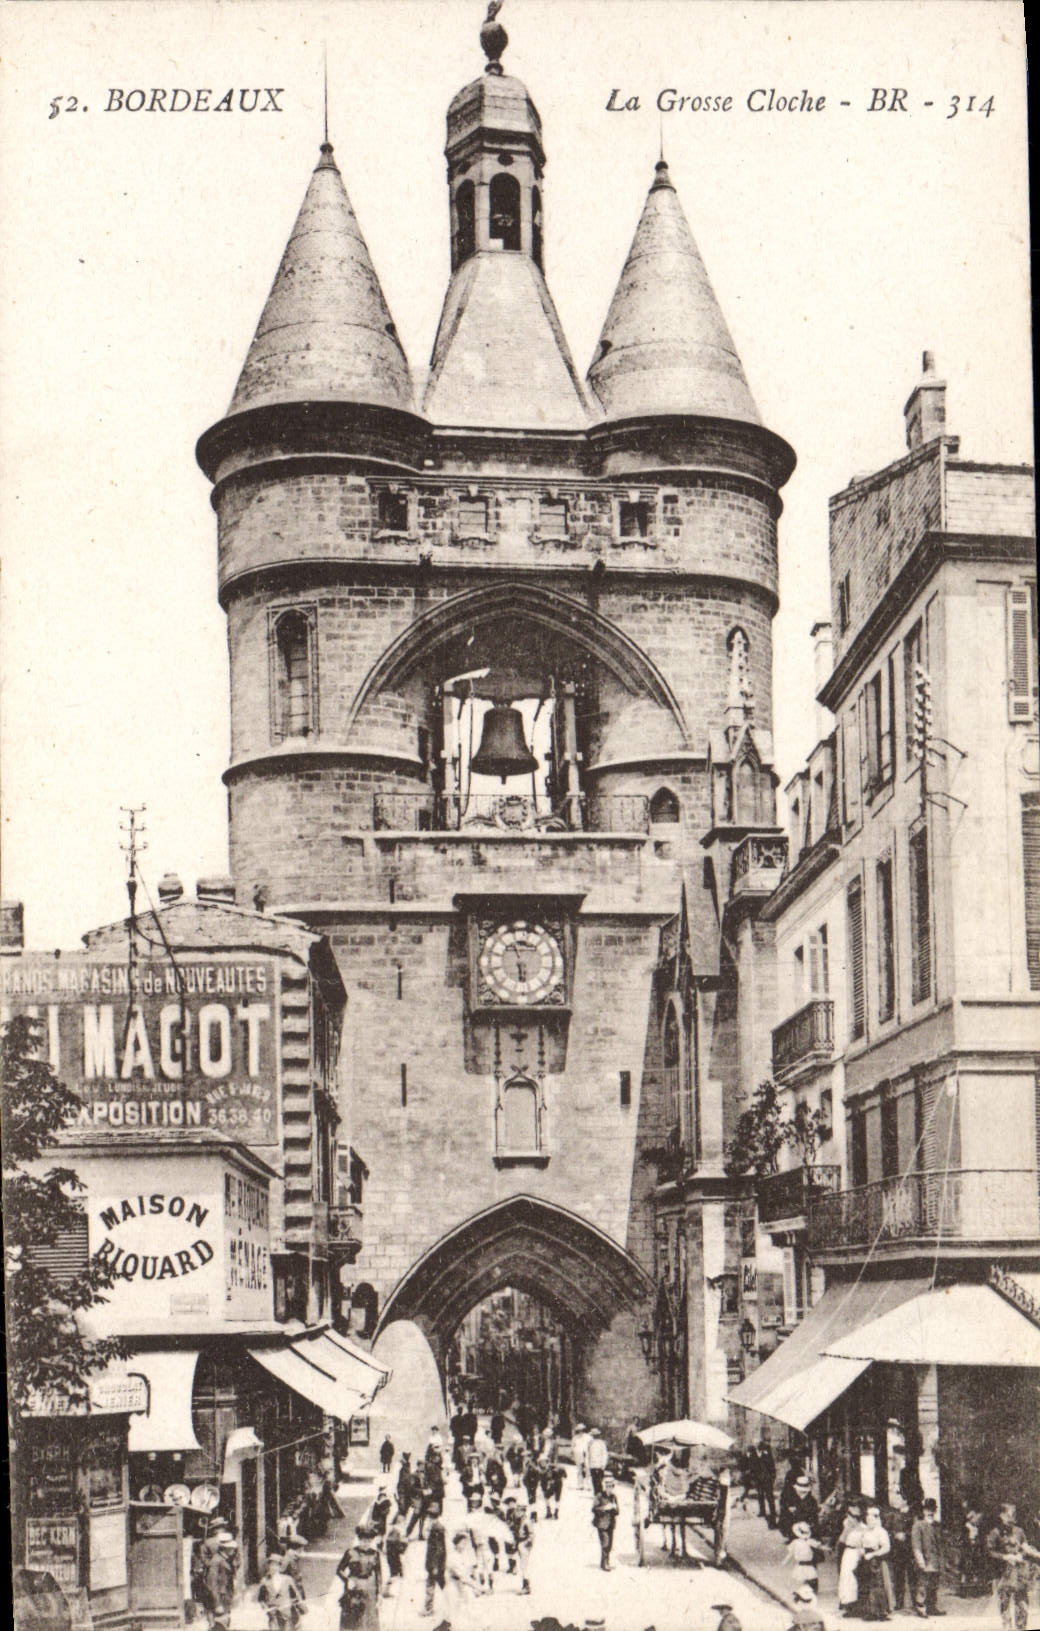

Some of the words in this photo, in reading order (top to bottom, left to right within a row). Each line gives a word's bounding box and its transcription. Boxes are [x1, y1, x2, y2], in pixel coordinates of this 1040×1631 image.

[143, 975, 162, 994] de
[83, 1003, 271, 1079] MAGOT
[100, 1194, 209, 1231] MAISON
[95, 1237, 214, 1283] RIQUARD
